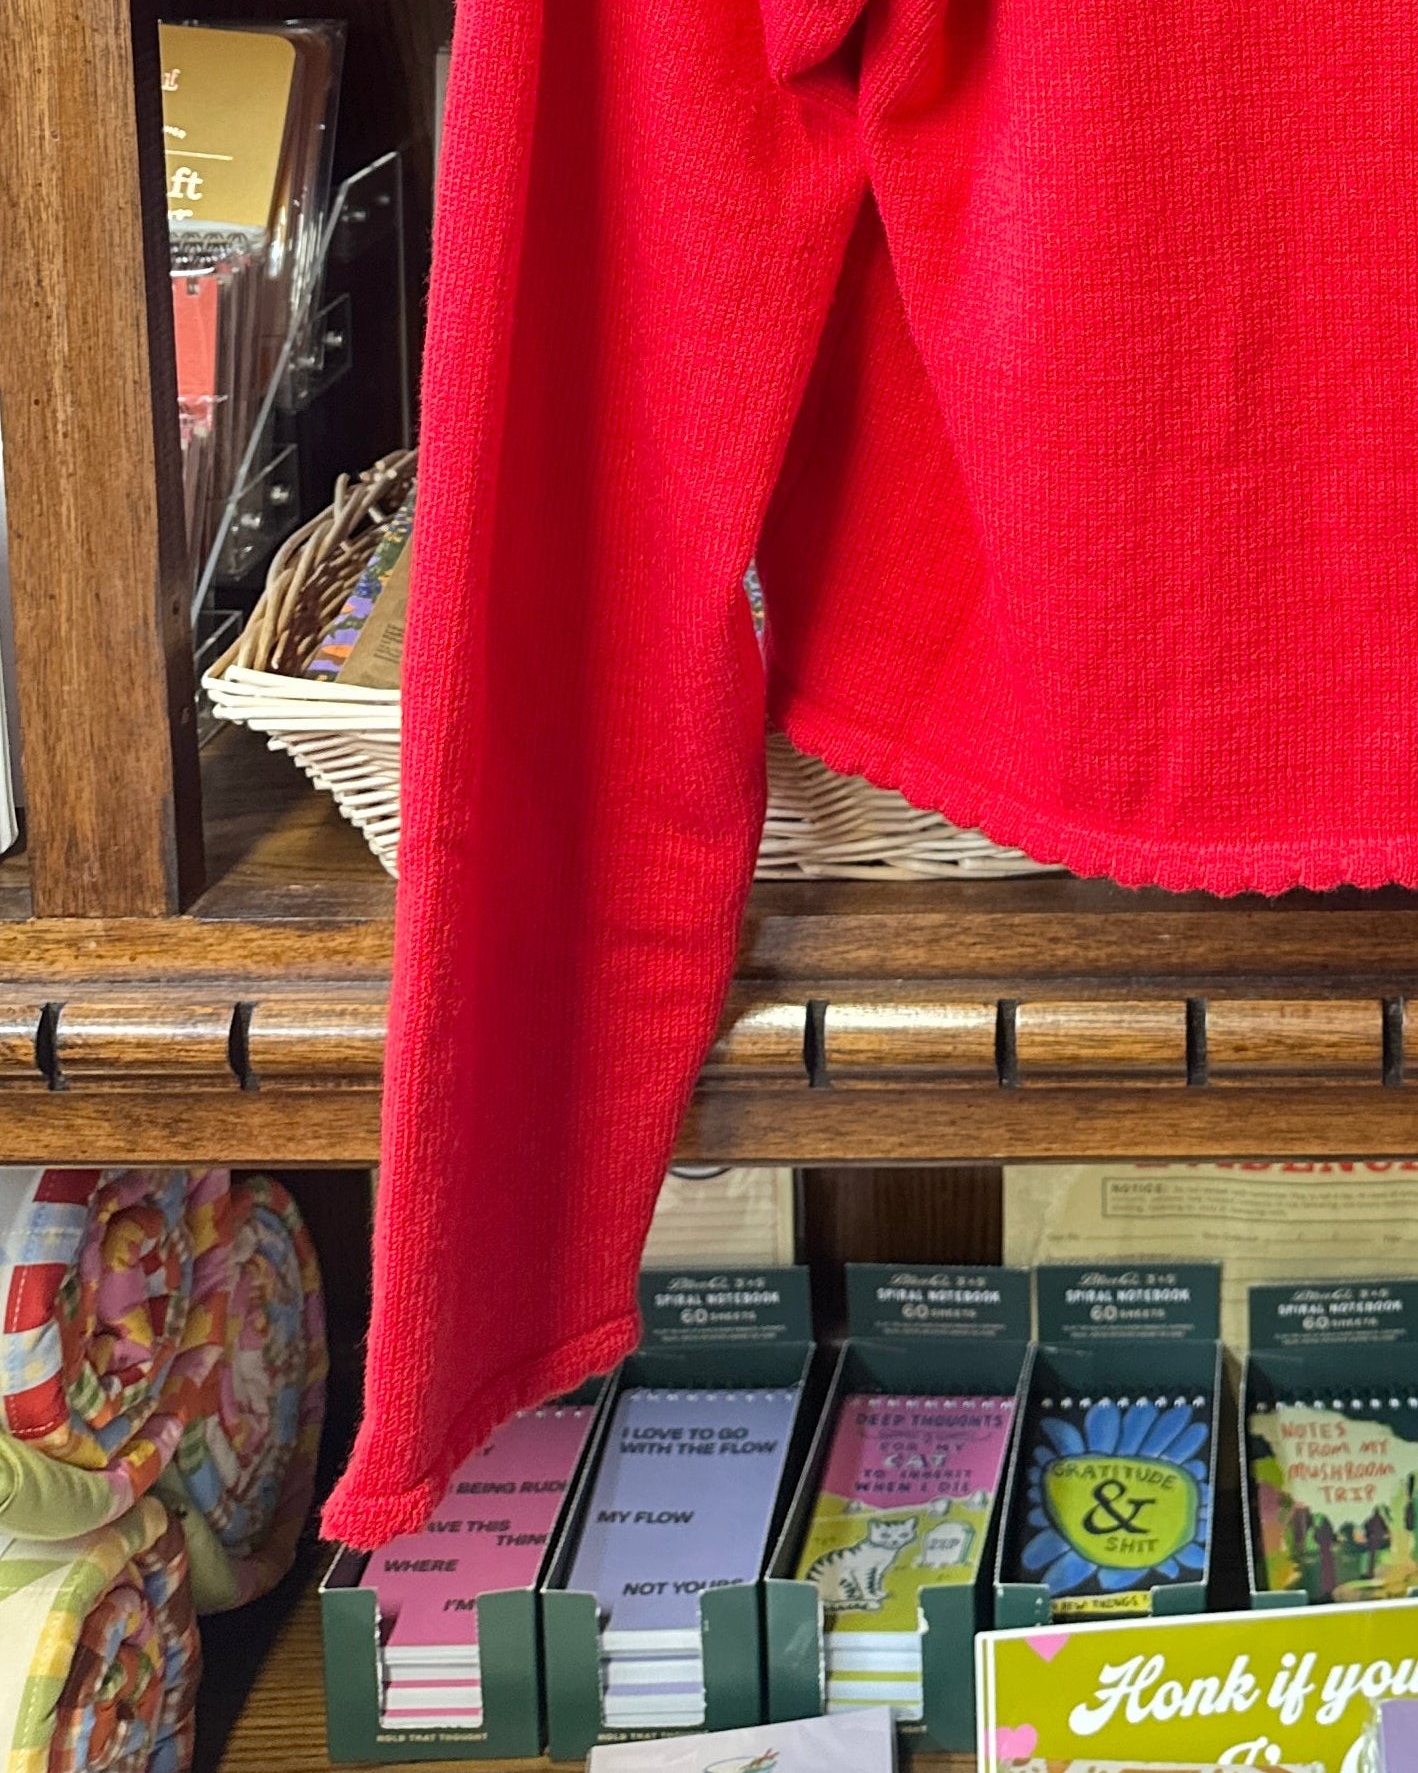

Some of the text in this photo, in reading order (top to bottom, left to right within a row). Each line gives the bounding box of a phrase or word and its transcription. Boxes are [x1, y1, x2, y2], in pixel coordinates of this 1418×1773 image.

[633, 1428, 683, 1440] LOVE
[687, 1428, 714, 1440] TO
[719, 1428, 749, 1440] GO
[1280, 1420, 1347, 1438] NOTES
[620, 1440, 778, 1455] WITH THE FLOW
[1295, 1441, 1350, 1459] FROM
[1051, 1460, 1179, 1490] GRATITUDE
[456, 1482, 517, 1494] BEING
[1082, 1478, 1156, 1534] &
[597, 1511, 694, 1524] MY FLOW
[428, 1520, 511, 1533] AVE THIS
[1104, 1536, 1159, 1554] SHIT
[384, 1559, 459, 1572] WHERE
[623, 1582, 668, 1595] NOT
[1068, 1652, 1262, 1736] Honk
[1266, 1651, 1320, 1726] if
